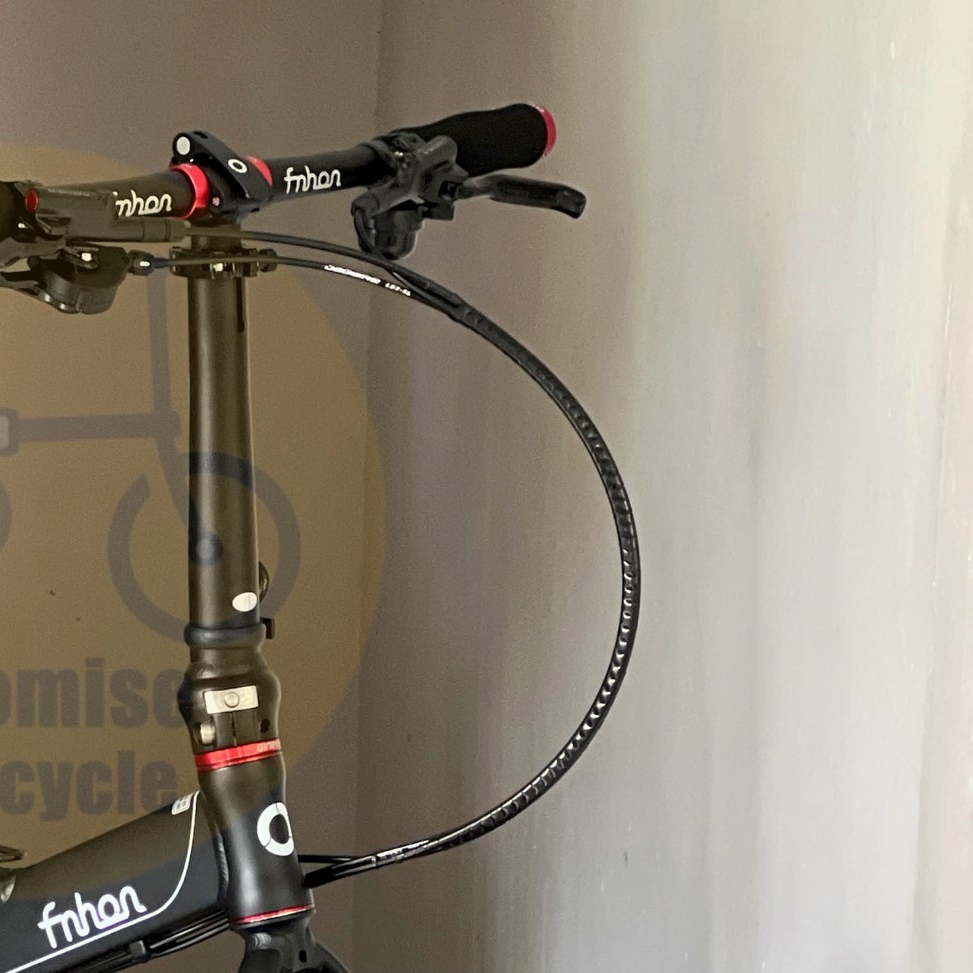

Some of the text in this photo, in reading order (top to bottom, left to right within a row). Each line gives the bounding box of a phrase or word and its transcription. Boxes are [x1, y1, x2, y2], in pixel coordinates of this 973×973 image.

[284, 165, 342, 195] fnhon
[112, 190, 172, 218] nhon
[37, 885, 148, 949] fnhon
